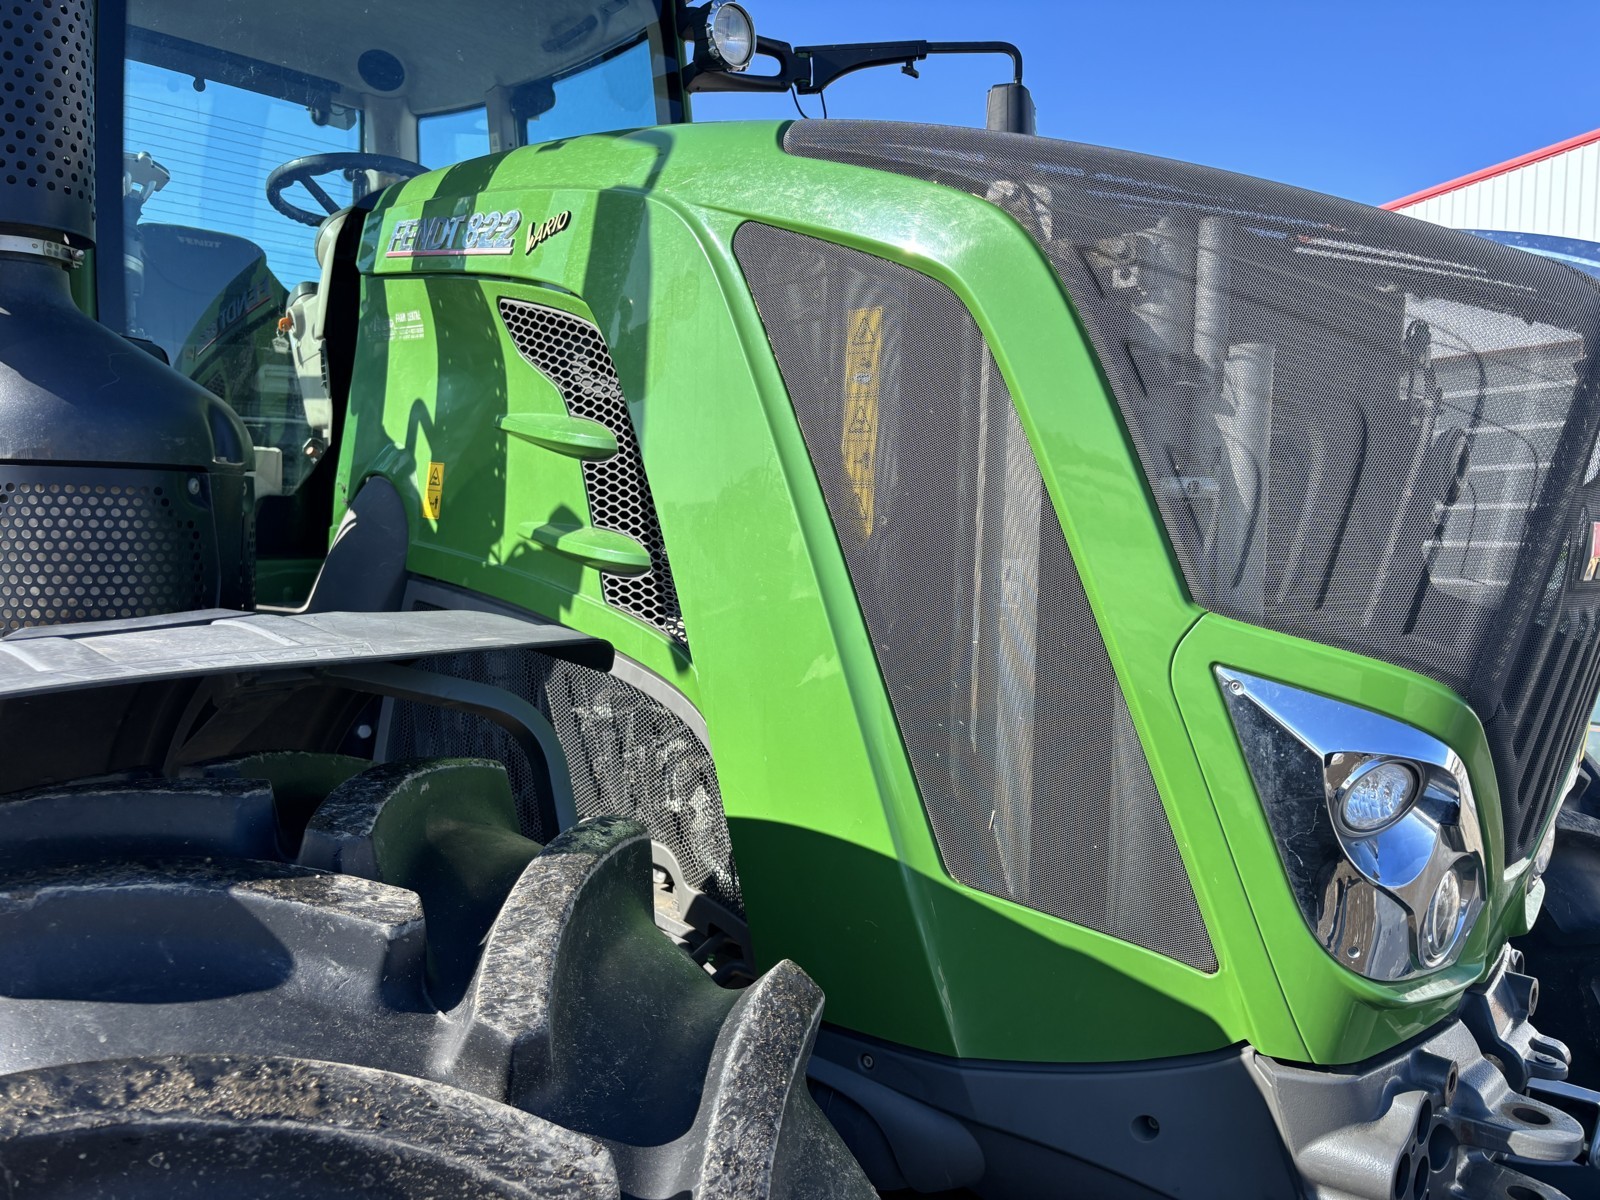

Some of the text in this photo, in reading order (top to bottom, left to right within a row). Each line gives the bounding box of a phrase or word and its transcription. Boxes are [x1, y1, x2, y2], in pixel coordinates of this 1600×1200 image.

[387, 210, 572, 256] FENDT 822 VARIO
